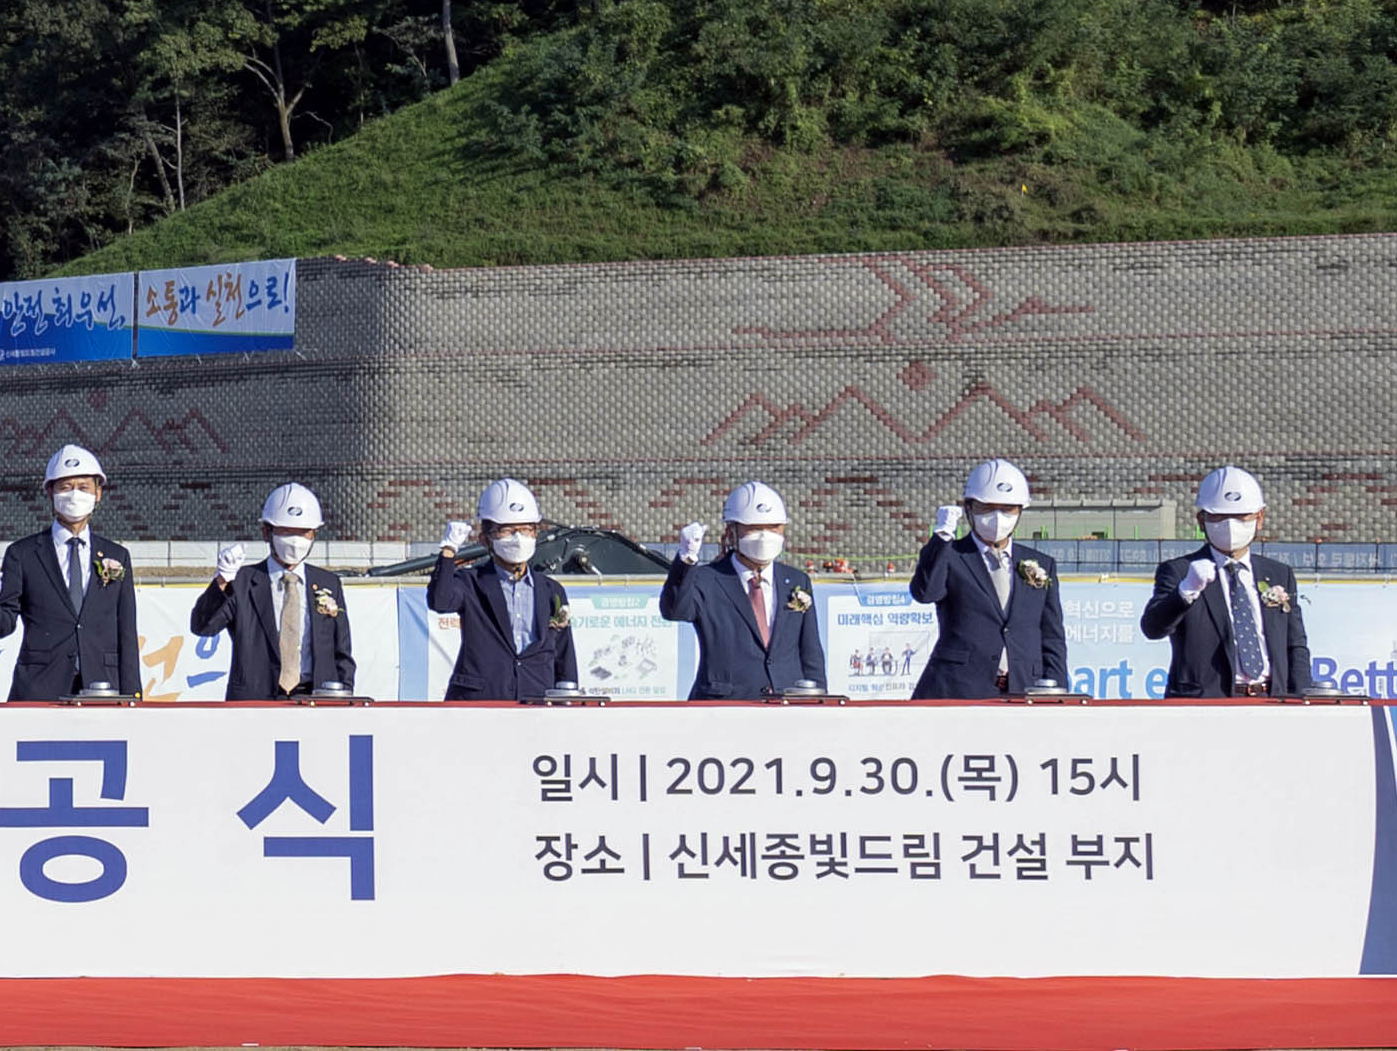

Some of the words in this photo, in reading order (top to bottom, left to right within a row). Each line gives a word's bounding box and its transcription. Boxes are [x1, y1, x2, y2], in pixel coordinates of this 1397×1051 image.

[146, 280, 200, 326] 소통과
[533, 754, 618, 801] 일시
[667, 754, 1018, 802] 2021.9.30.(목)
[1040, 754, 1139, 801] 15시
[535, 833, 624, 881] 장소
[670, 832, 940, 880] 신세종빛드림
[962, 833, 1048, 880] 건설
[1066, 833, 1153, 880] 부지
